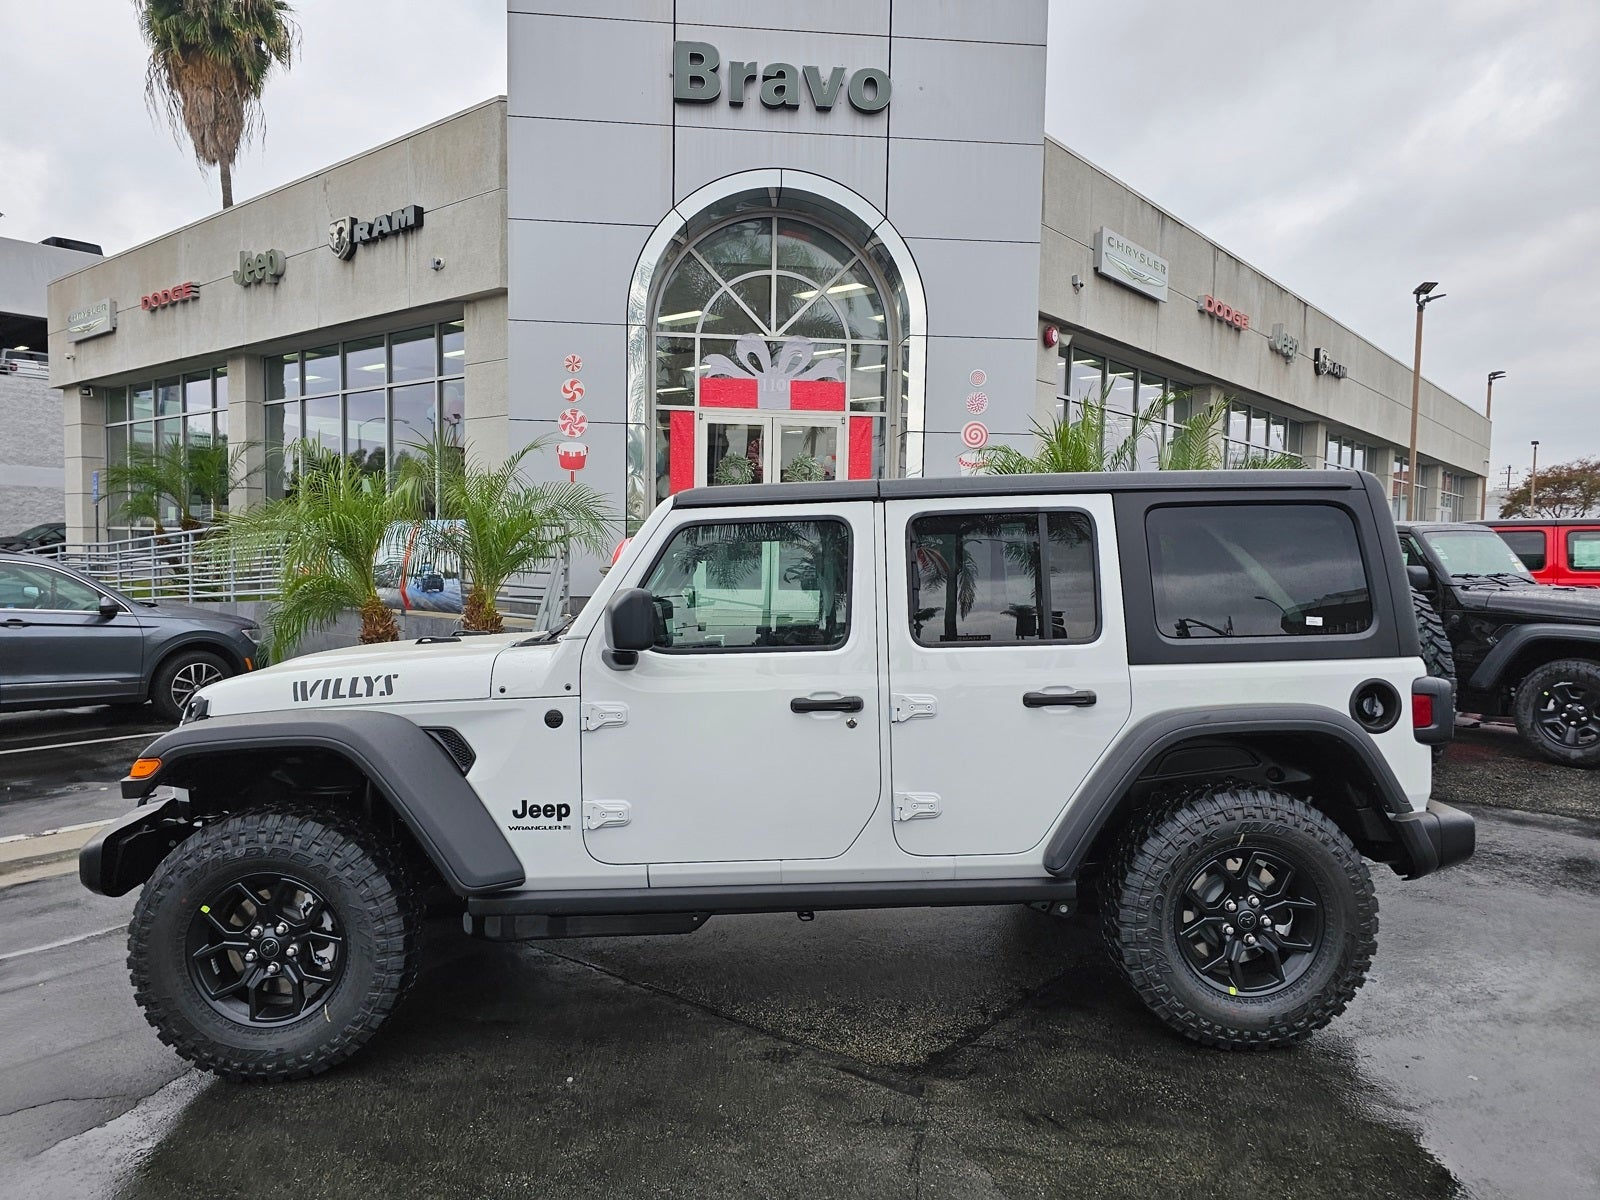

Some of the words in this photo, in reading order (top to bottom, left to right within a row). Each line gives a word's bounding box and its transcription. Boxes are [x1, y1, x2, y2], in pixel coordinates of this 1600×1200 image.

[673, 40, 892, 114] Bravo
[353, 205, 417, 244] RAM
[232, 249, 283, 286] Jeep
[1107, 236, 1167, 275] CHRYSLER
[141, 281, 195, 311] DODGE
[1203, 294, 1249, 331] DODGE
[1269, 323, 1299, 362] Jeep
[1327, 359, 1348, 378] RAM
[293, 673, 399, 702] WILLYS
[512, 799, 571, 822] Jeep
